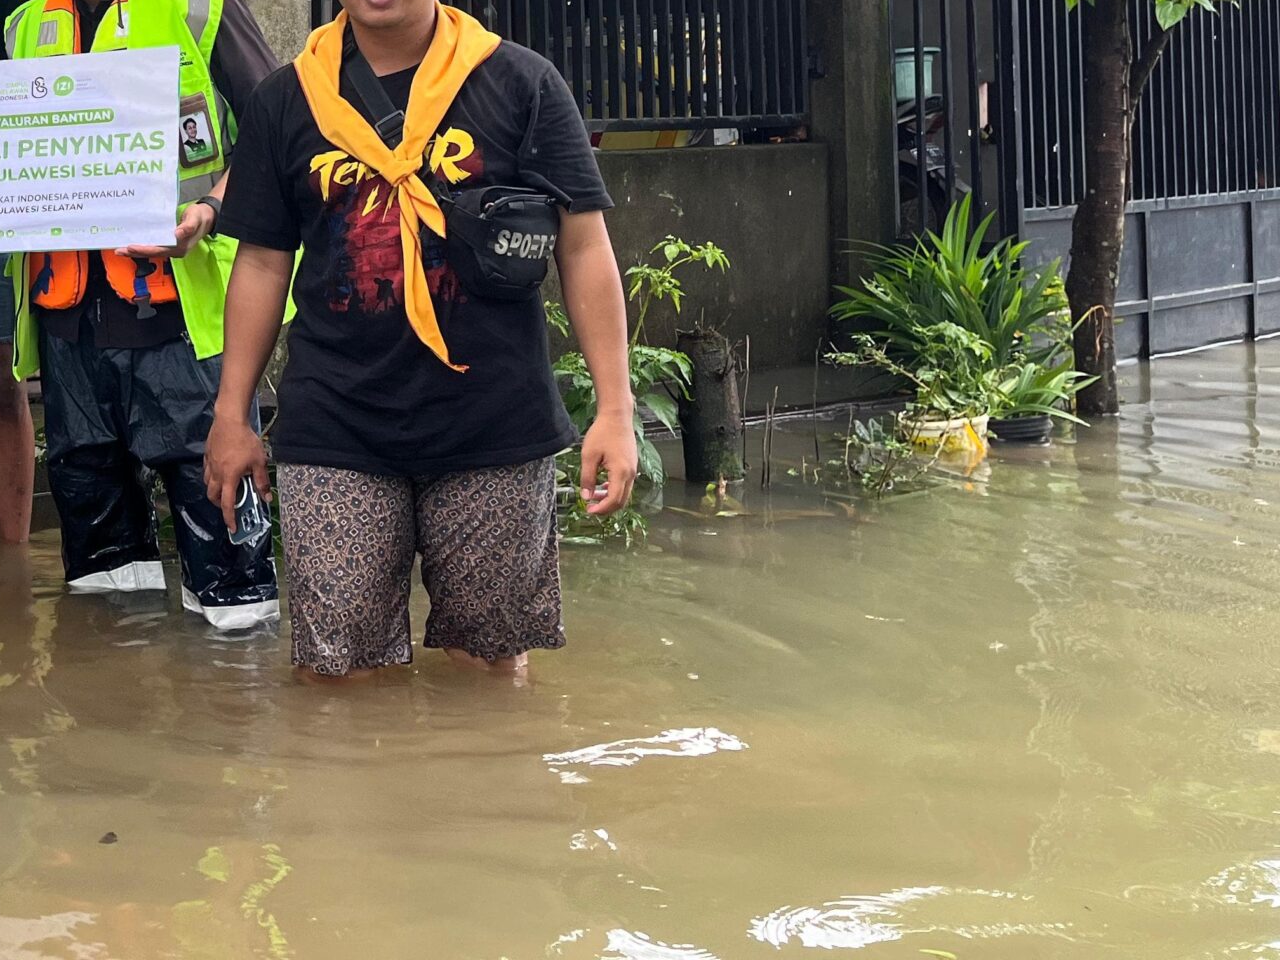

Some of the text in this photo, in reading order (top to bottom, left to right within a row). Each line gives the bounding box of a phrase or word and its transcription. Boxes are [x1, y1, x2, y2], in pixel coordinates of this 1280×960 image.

[56, 82, 71, 91] IZI
[52, 110, 111, 124] BANTUAN
[18, 130, 166, 158] PENYINTAS
[82, 159, 163, 177] SELATAN
[18, 193, 70, 203] INDONESIA
[72, 189, 135, 200] PERWAKILAN
[42, 203, 84, 212] SELATAN
